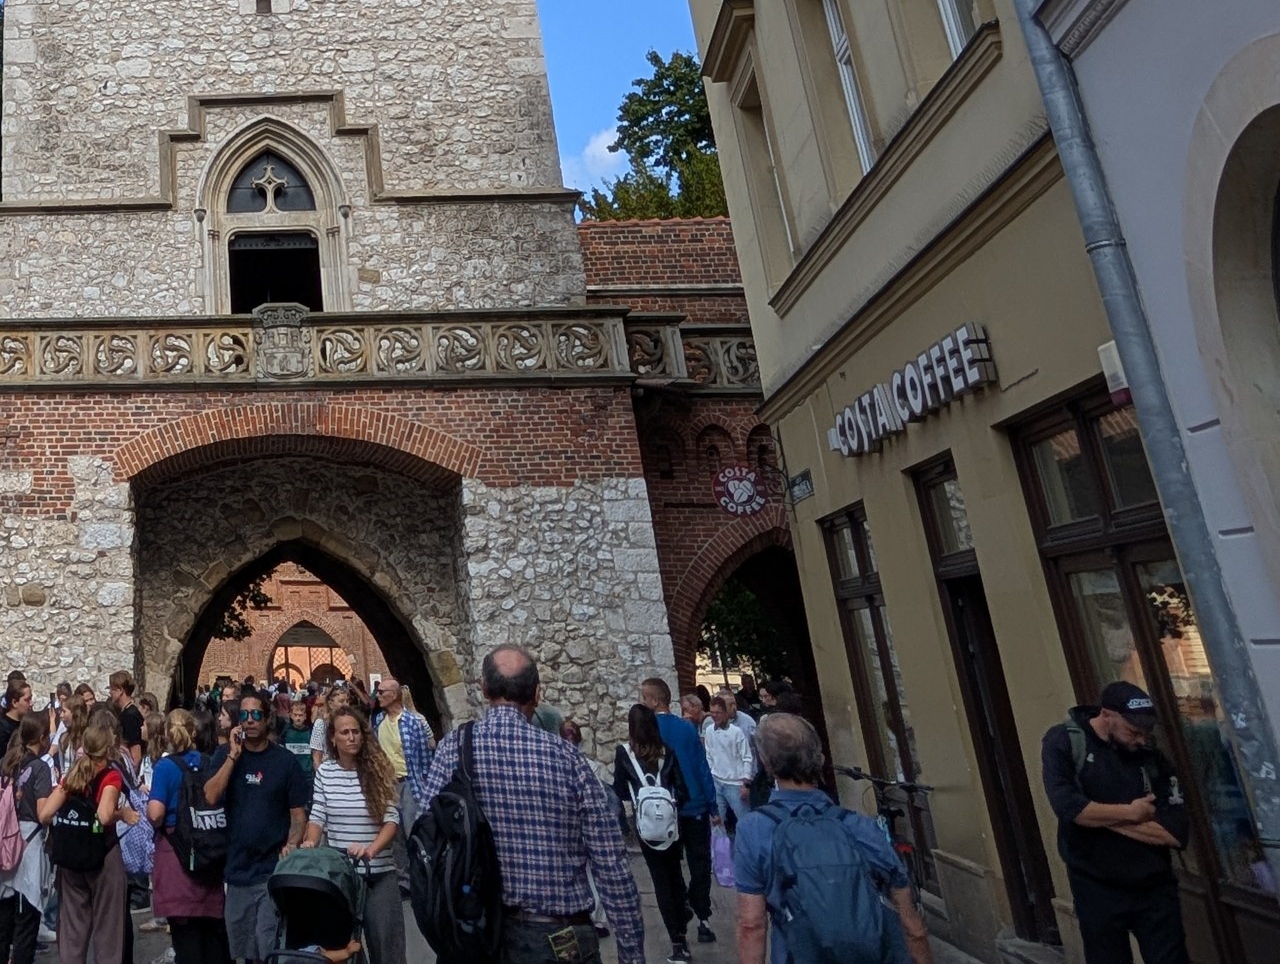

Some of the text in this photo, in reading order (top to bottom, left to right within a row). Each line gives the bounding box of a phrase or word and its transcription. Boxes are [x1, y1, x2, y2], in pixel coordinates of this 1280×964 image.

[835, 325, 980, 456] COSTA COFFEE
[718, 466, 756, 482] COSTA
[720, 495, 766, 515] COFFEE
[189, 806, 227, 830] VANS
